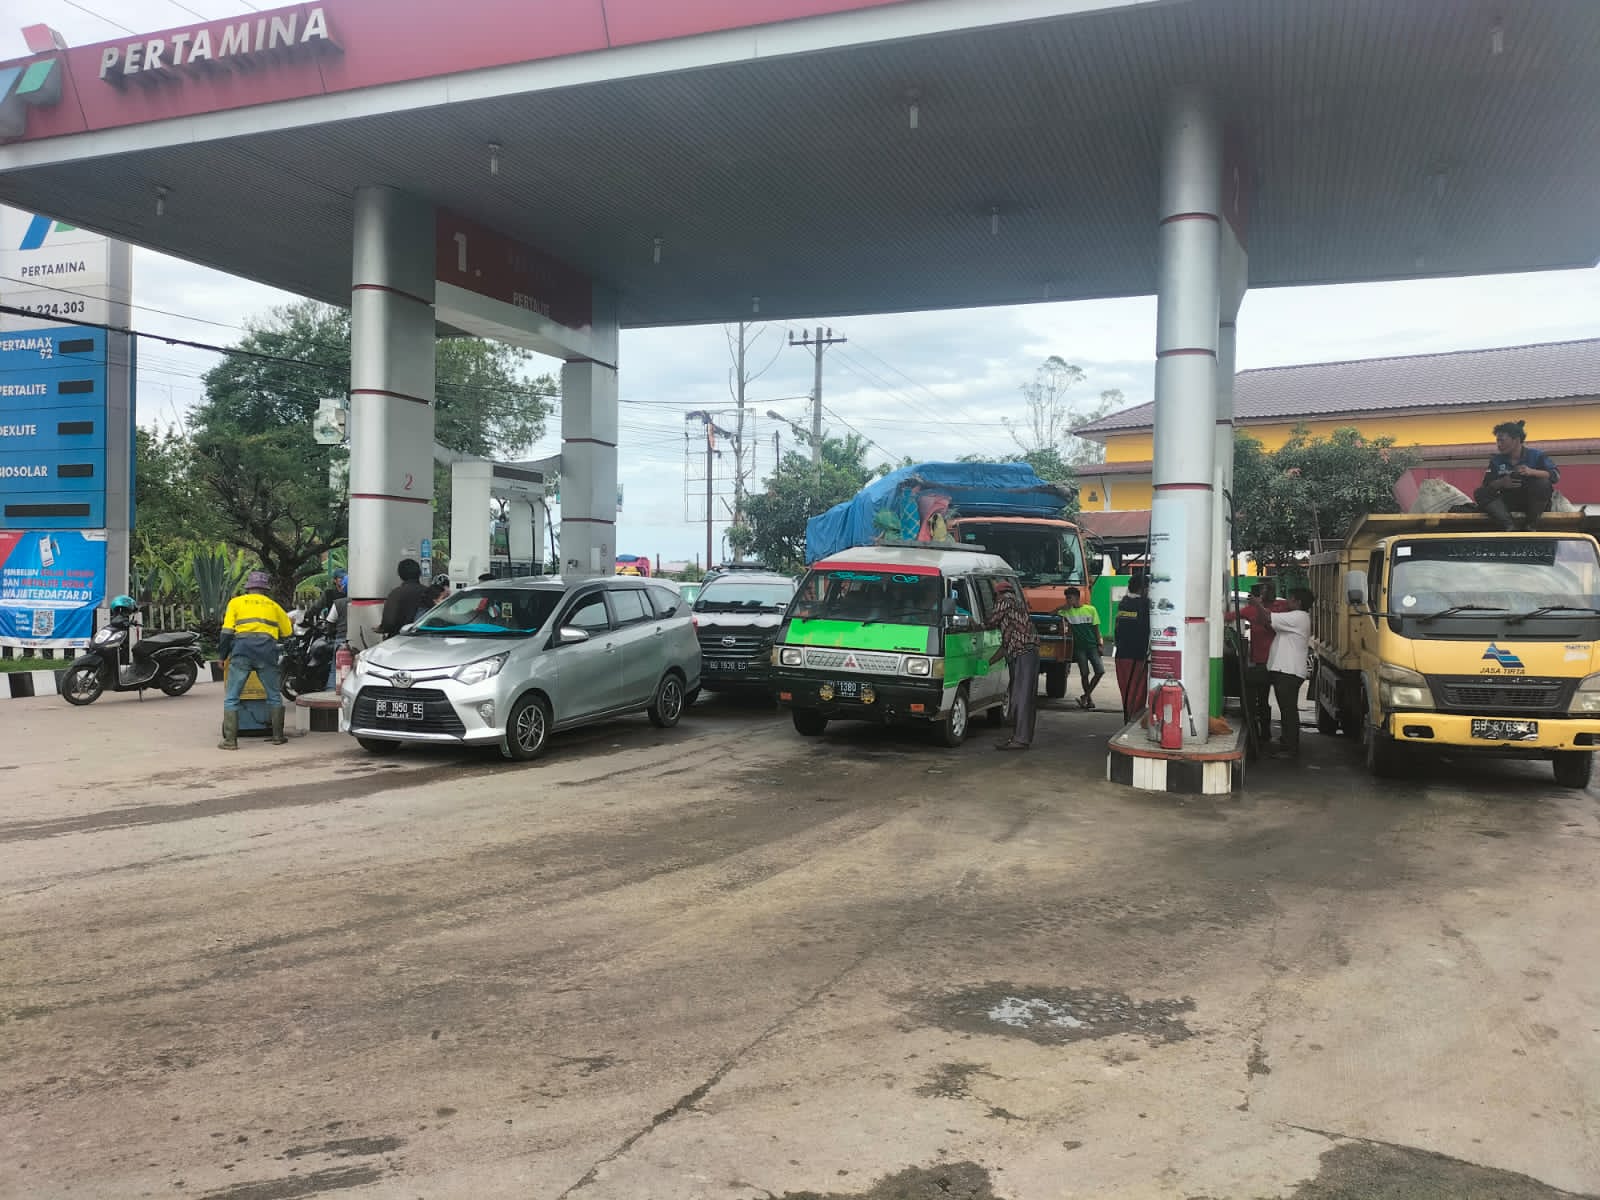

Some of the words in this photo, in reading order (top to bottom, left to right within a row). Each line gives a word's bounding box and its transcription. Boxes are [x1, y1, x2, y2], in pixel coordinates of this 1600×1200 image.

[101, 8, 329, 79] PERTAMINA
[21, 261, 86, 277] PERTAMINA
[20, 301, 85, 317] 4224.303
[404, 472, 413, 490] 2
[81, 590, 93, 601] DI
[391, 702, 408, 713] 1950
